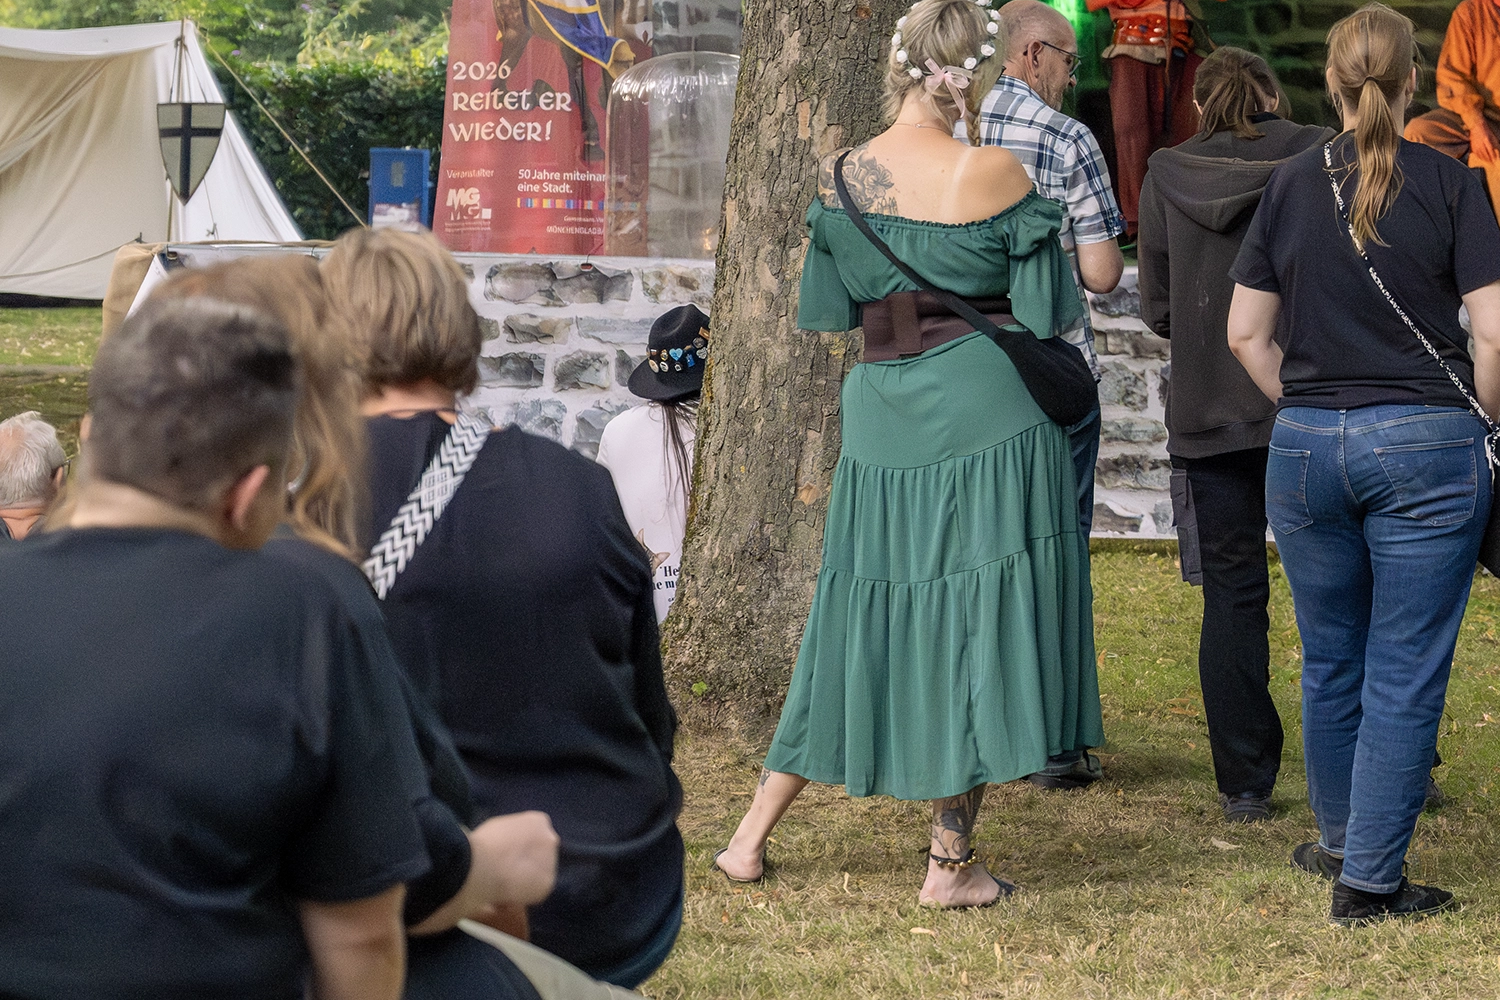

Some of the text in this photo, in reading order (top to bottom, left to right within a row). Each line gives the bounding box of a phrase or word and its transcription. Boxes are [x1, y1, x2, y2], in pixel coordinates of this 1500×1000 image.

[452, 59, 512, 81] 2026
[517, 168, 606, 182] 50 Jahre miteina
[517, 182, 573, 193] eine Stadt.
